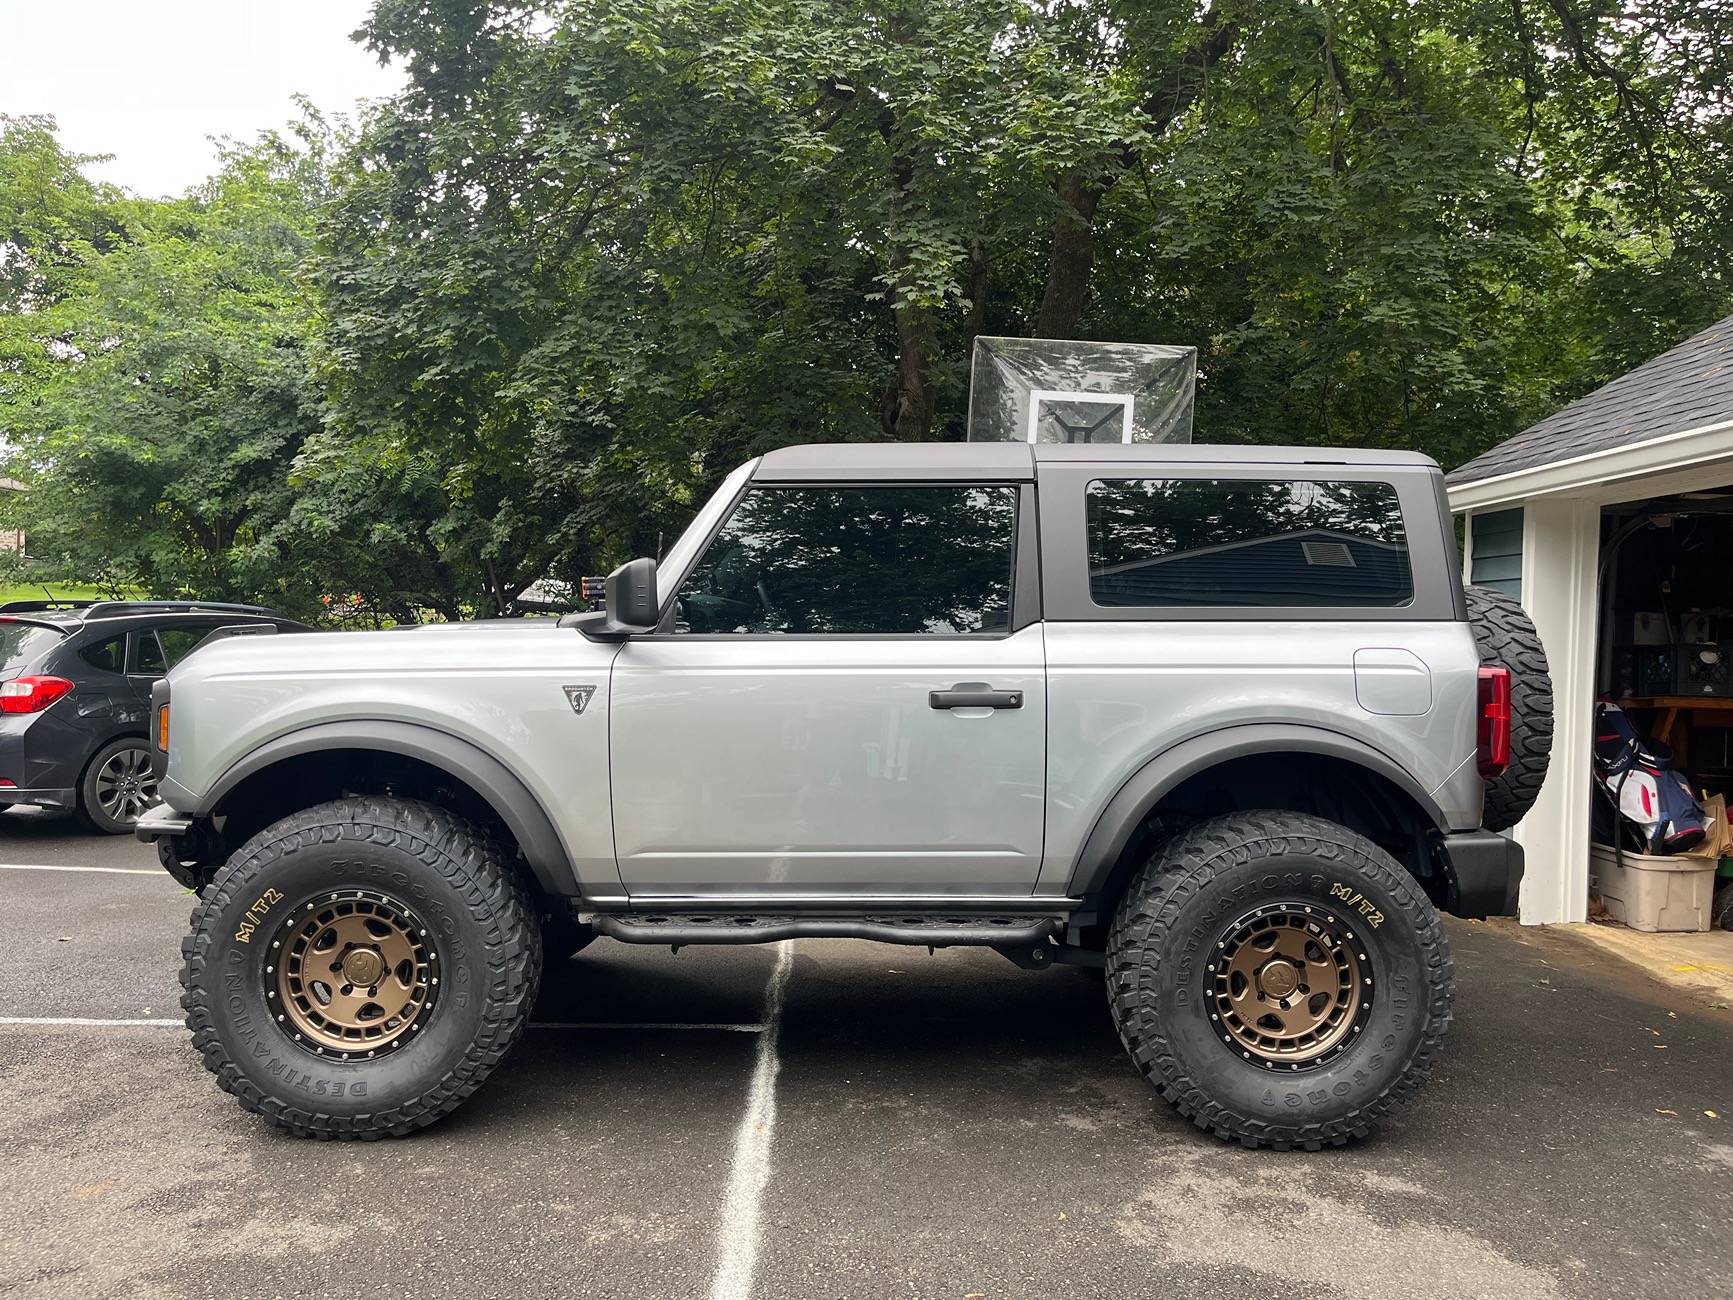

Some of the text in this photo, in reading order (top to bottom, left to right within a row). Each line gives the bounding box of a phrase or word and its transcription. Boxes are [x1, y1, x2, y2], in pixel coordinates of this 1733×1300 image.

[223, 886, 369, 1098] DESTINATION M/T2
[1175, 874, 1386, 1007] DESTINATION M/T2
